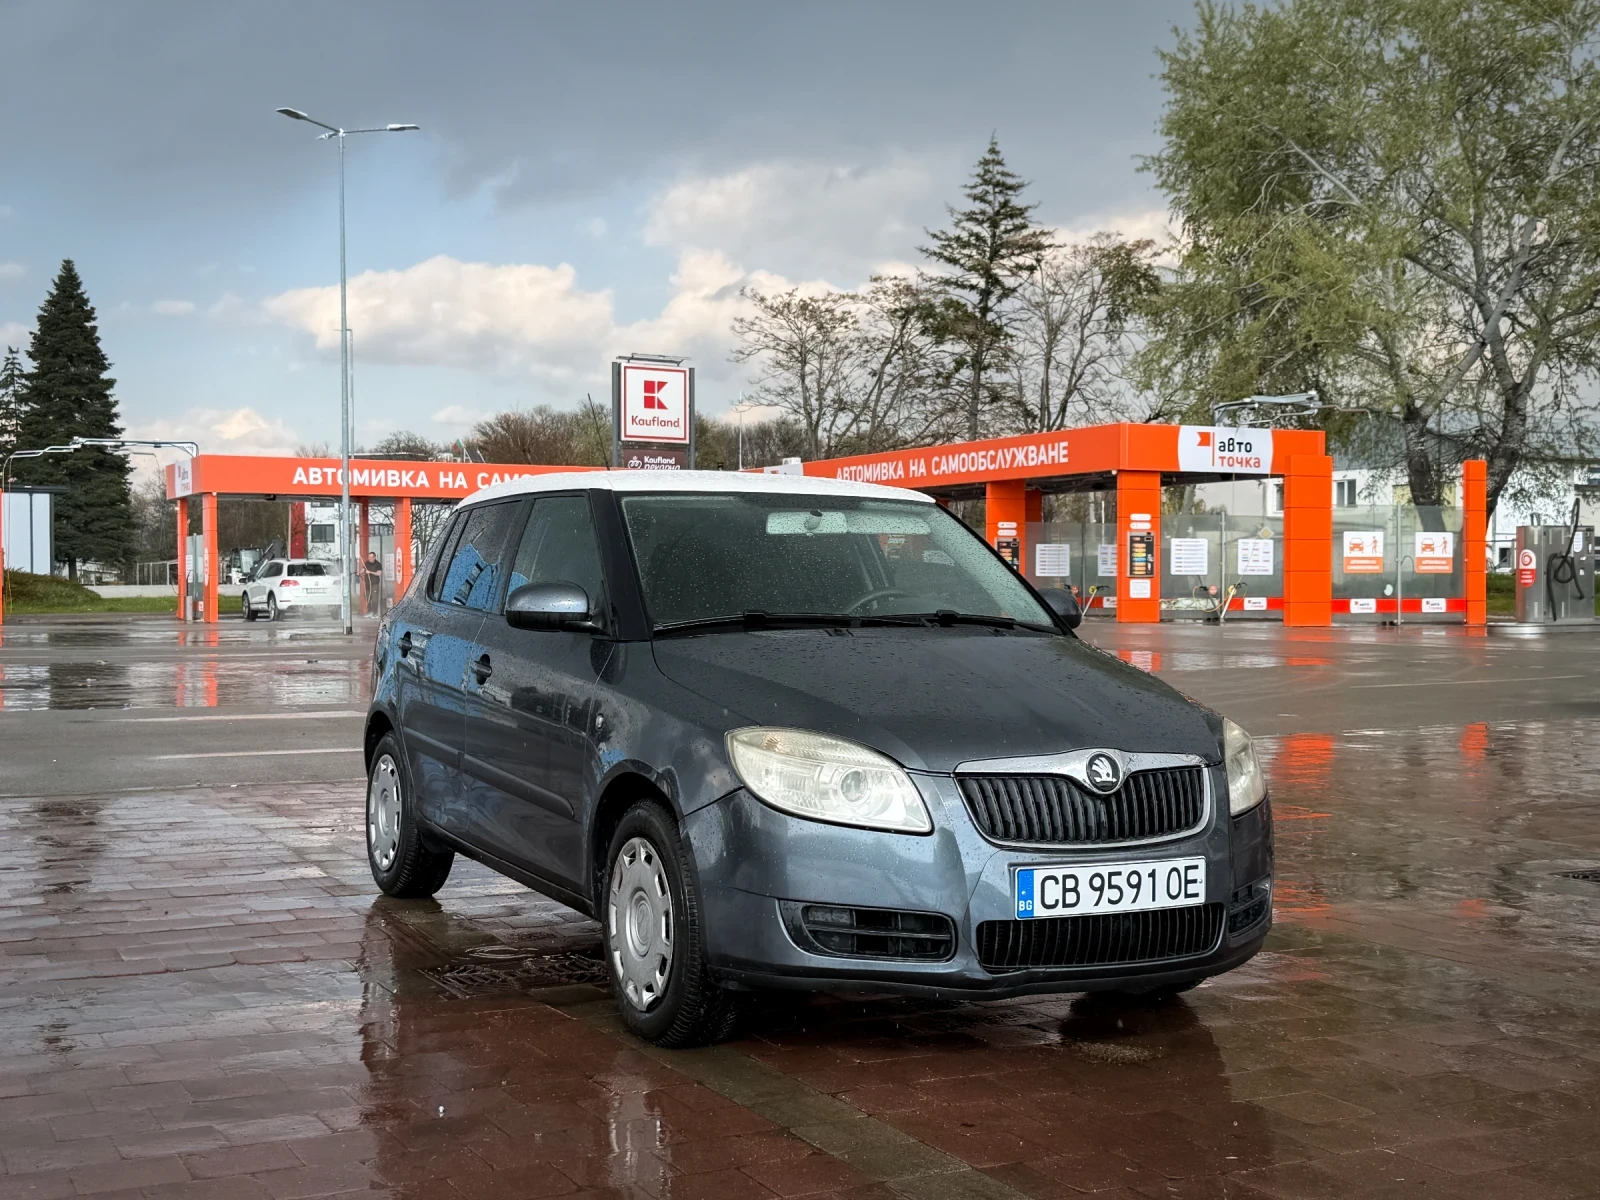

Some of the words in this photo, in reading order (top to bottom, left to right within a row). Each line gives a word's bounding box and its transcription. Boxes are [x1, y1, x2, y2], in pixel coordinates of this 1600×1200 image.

[631, 415, 680, 428] Kaufland
[1218, 437, 1252, 453] авто
[644, 455, 676, 465] Kaufland
[836, 460, 905, 482] АВТОМИВКА
[909, 458, 927, 478] НА
[931, 441, 1069, 475] САМООБСЛУЖВАНЕ
[1218, 455, 1261, 468] точка
[439, 471, 469, 489] НА
[1040, 873, 1081, 910] CB
[1088, 868, 1157, 907] 9591
[1018, 901, 1033, 911] BG
